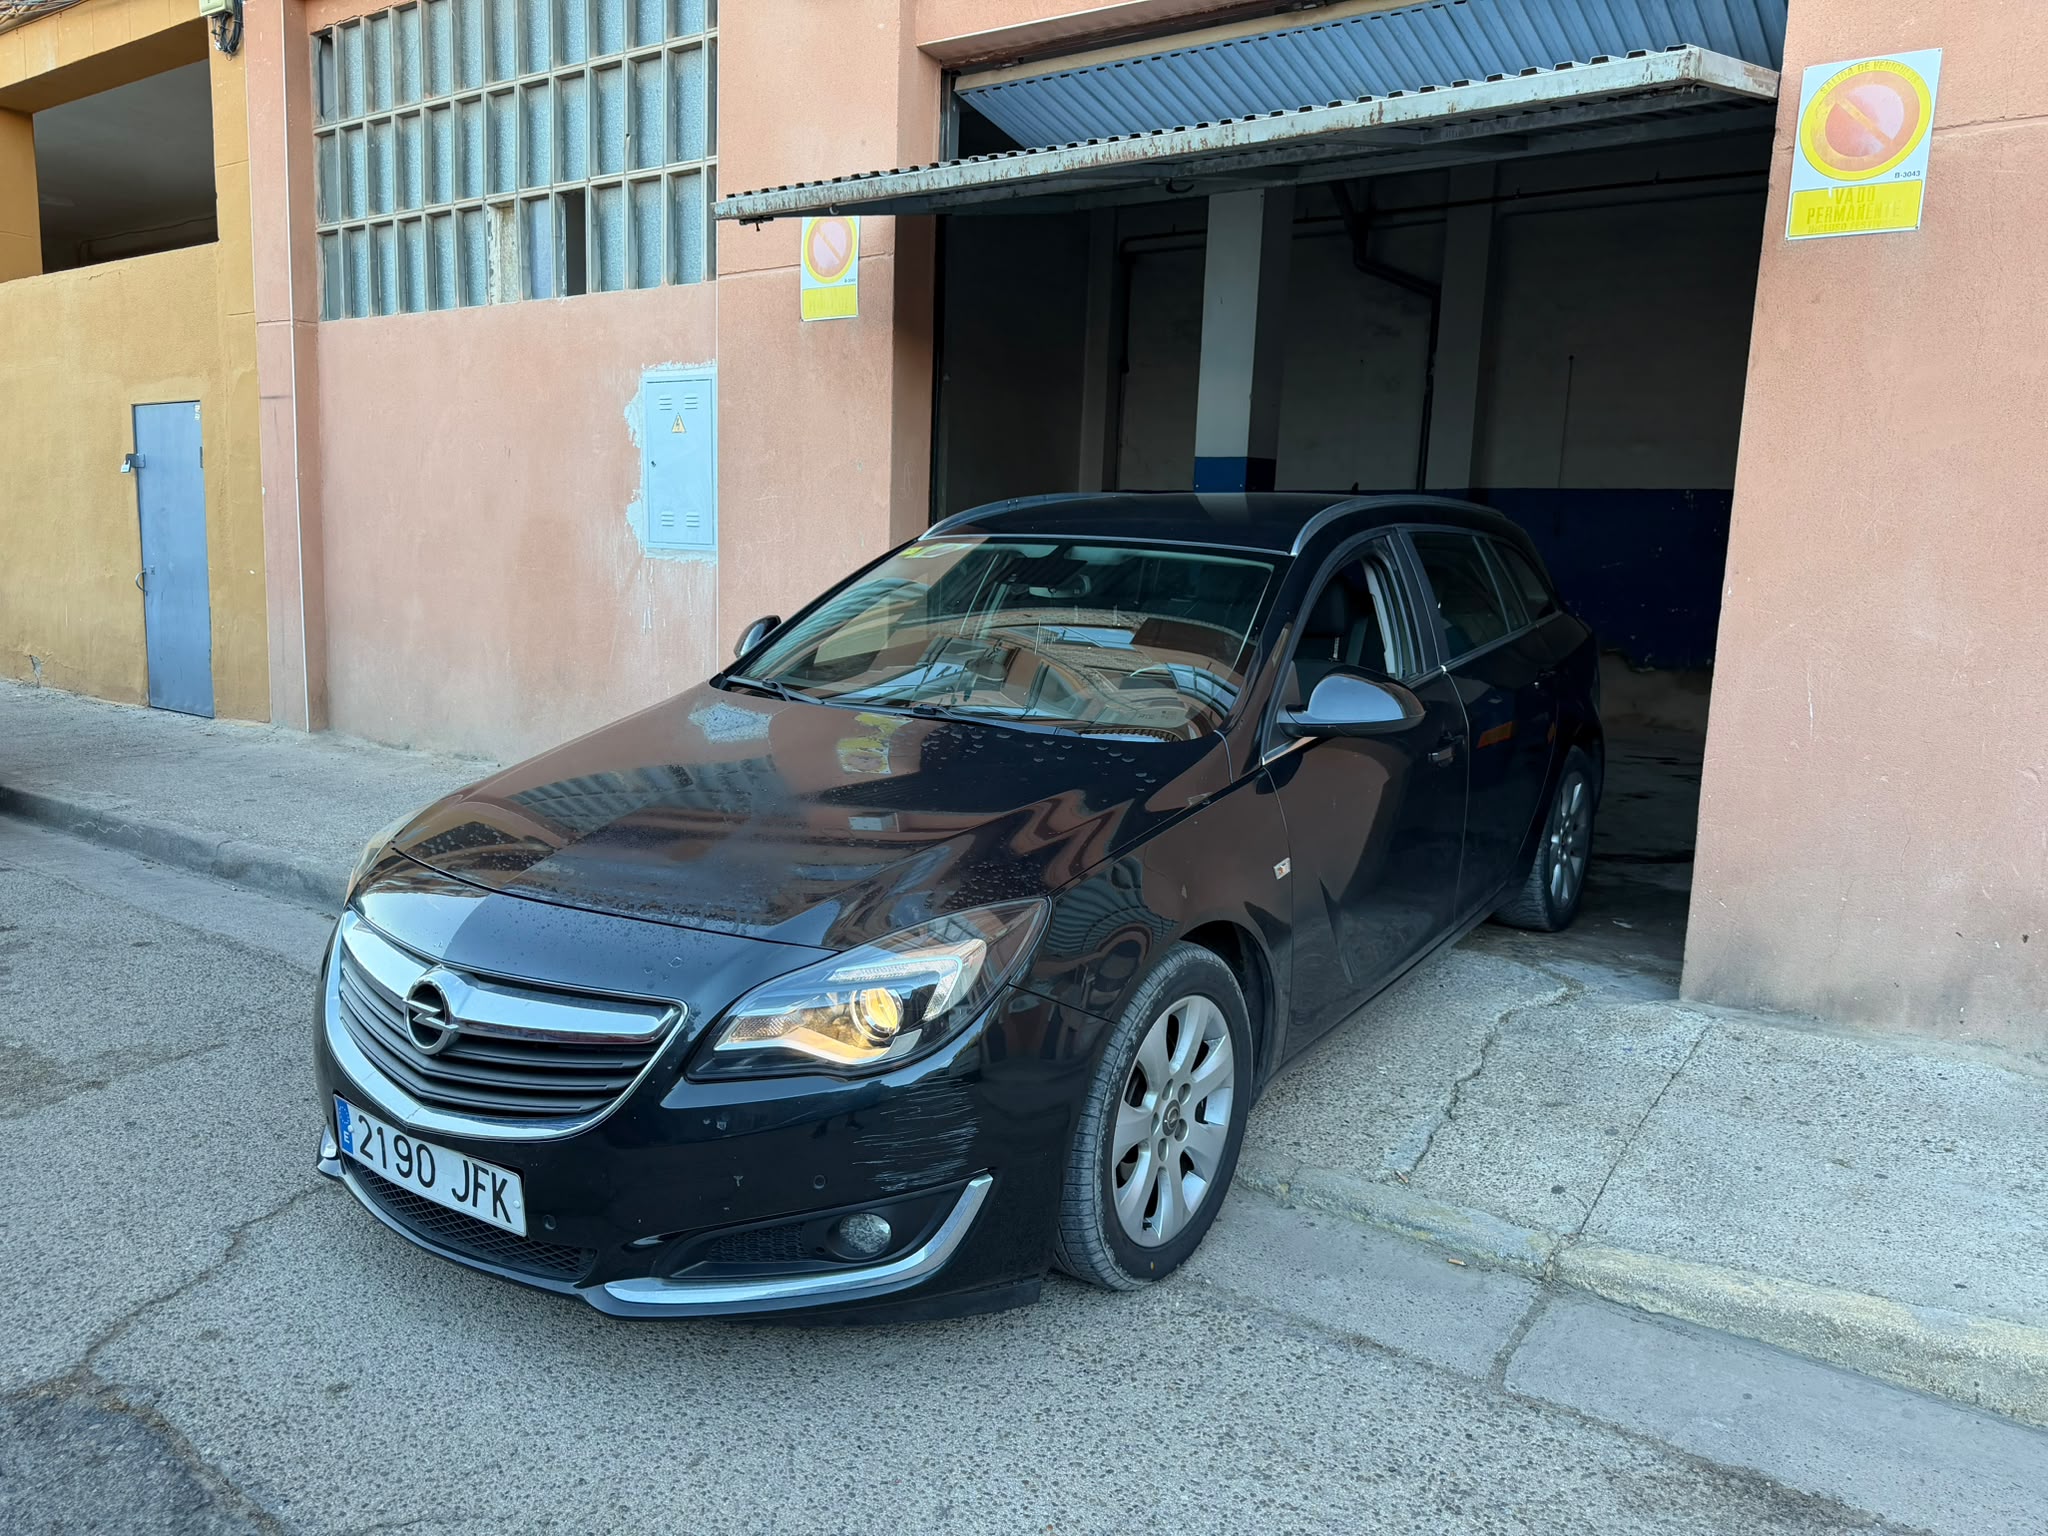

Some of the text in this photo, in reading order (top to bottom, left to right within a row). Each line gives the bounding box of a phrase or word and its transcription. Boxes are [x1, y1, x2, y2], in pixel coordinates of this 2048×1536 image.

[1857, 62, 1871, 71] DE
[1835, 186, 1876, 205] VADO
[343, 1129, 351, 1145] E
[358, 1114, 512, 1225] 2190 JFK
